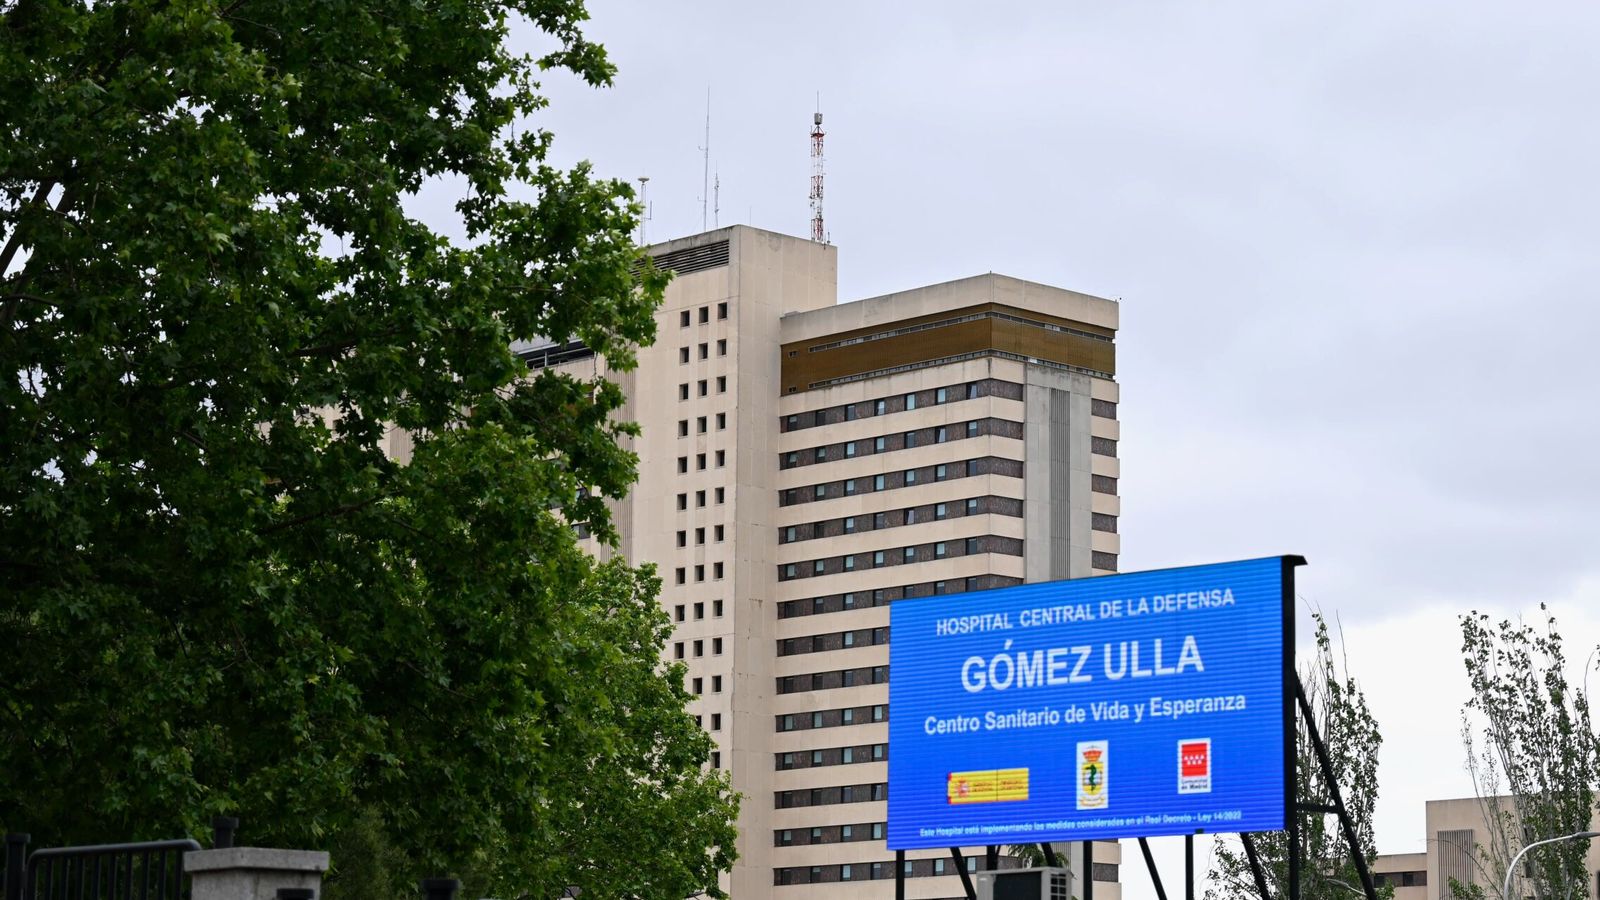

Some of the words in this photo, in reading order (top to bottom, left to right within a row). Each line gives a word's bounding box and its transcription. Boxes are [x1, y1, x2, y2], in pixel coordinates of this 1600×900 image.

[936, 612, 1013, 636] HOSPITAL
[1020, 603, 1095, 627] CENTRAL
[1100, 600, 1122, 619] DE
[1127, 597, 1150, 616] LA
[1153, 588, 1235, 613] DEFENSA
[961, 639, 1093, 693] GÓMEZ
[1104, 635, 1204, 680] ULLA
[924, 715, 980, 735] Centro
[985, 706, 1060, 730] Sanitario
[1065, 704, 1086, 723] de
[1090, 701, 1129, 721] Vida
[1134, 703, 1145, 723] y
[1150, 695, 1246, 719] Esperanza
[936, 826, 963, 837] Hospital
[1163, 813, 1191, 823] Decreto
[1198, 812, 1211, 823] Ley
